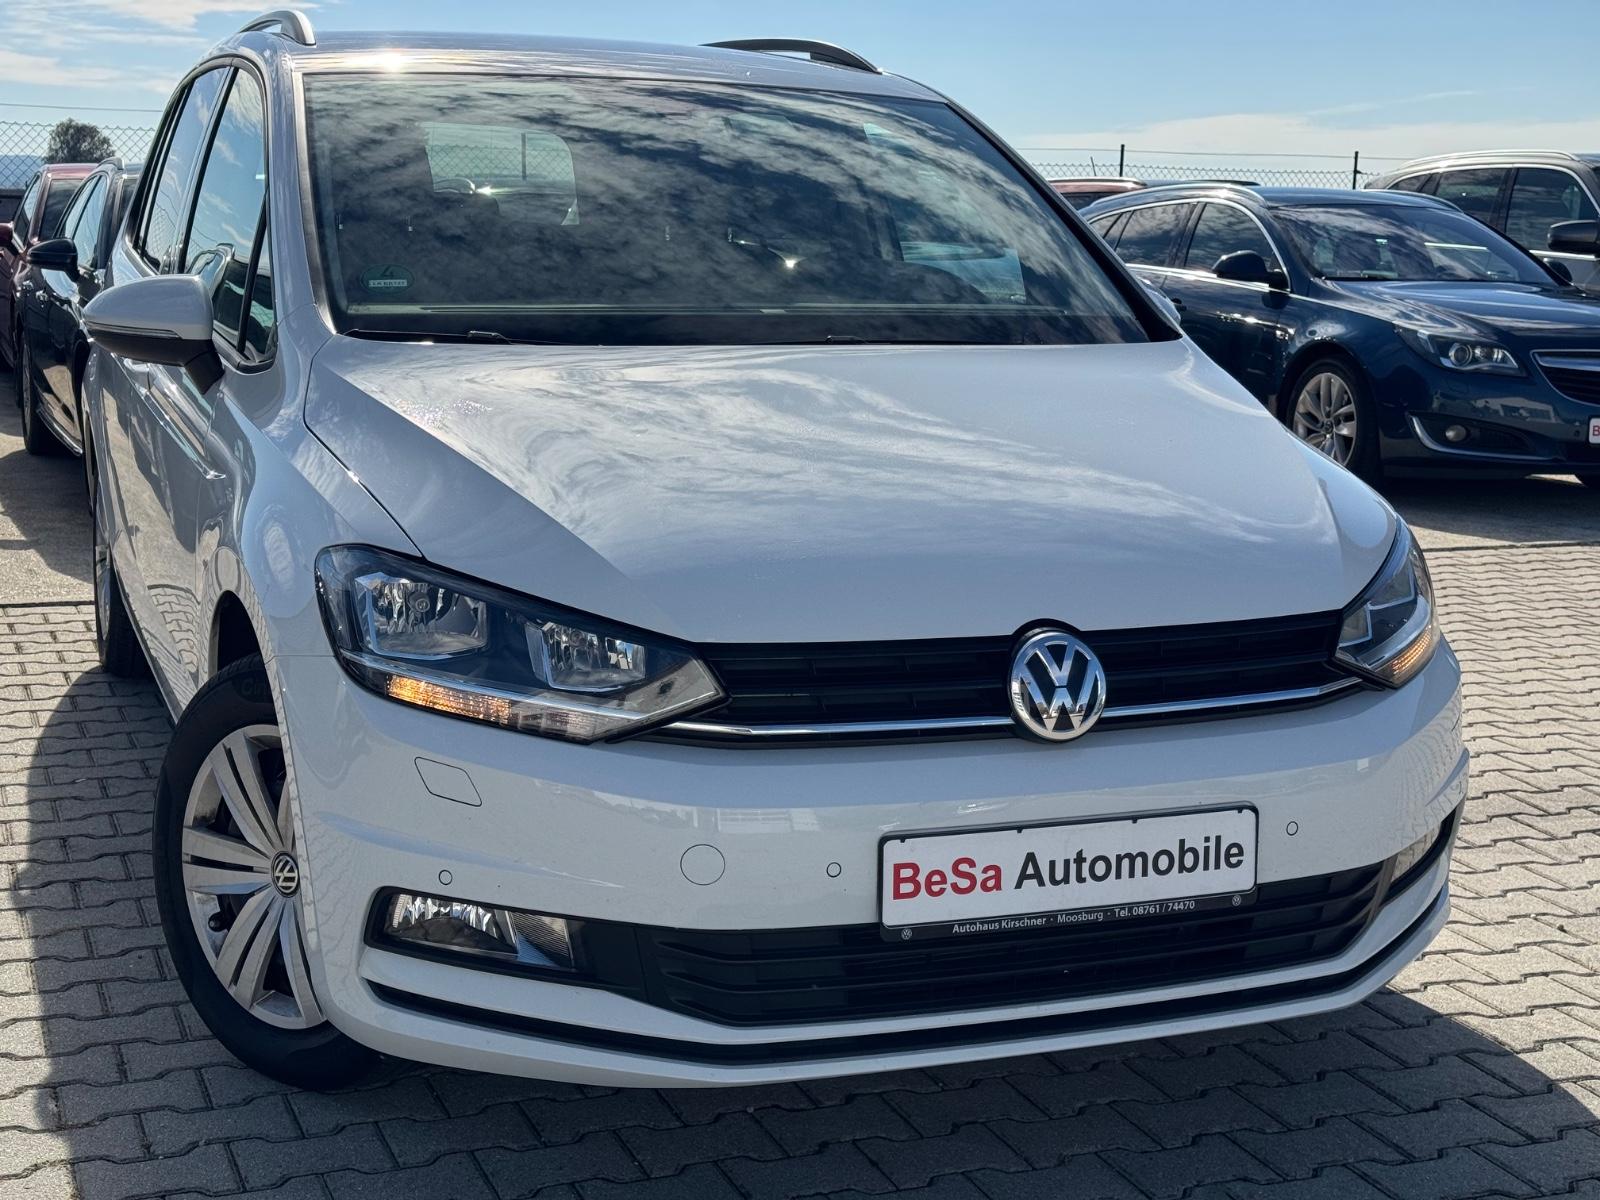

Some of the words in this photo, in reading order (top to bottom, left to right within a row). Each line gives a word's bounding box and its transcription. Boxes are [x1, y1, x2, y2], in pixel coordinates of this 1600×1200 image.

[892, 857, 1002, 900] BeSa
[1014, 835, 1244, 890] Automobile
[952, 922, 1000, 934] Autohaus
[1001, 917, 1047, 929] Kirschner
[1057, 912, 1104, 922] Moosburg
[1114, 908, 1131, 917] Tel.
[1132, 904, 1160, 916] 08761
[1167, 901, 1196, 911] 74470
